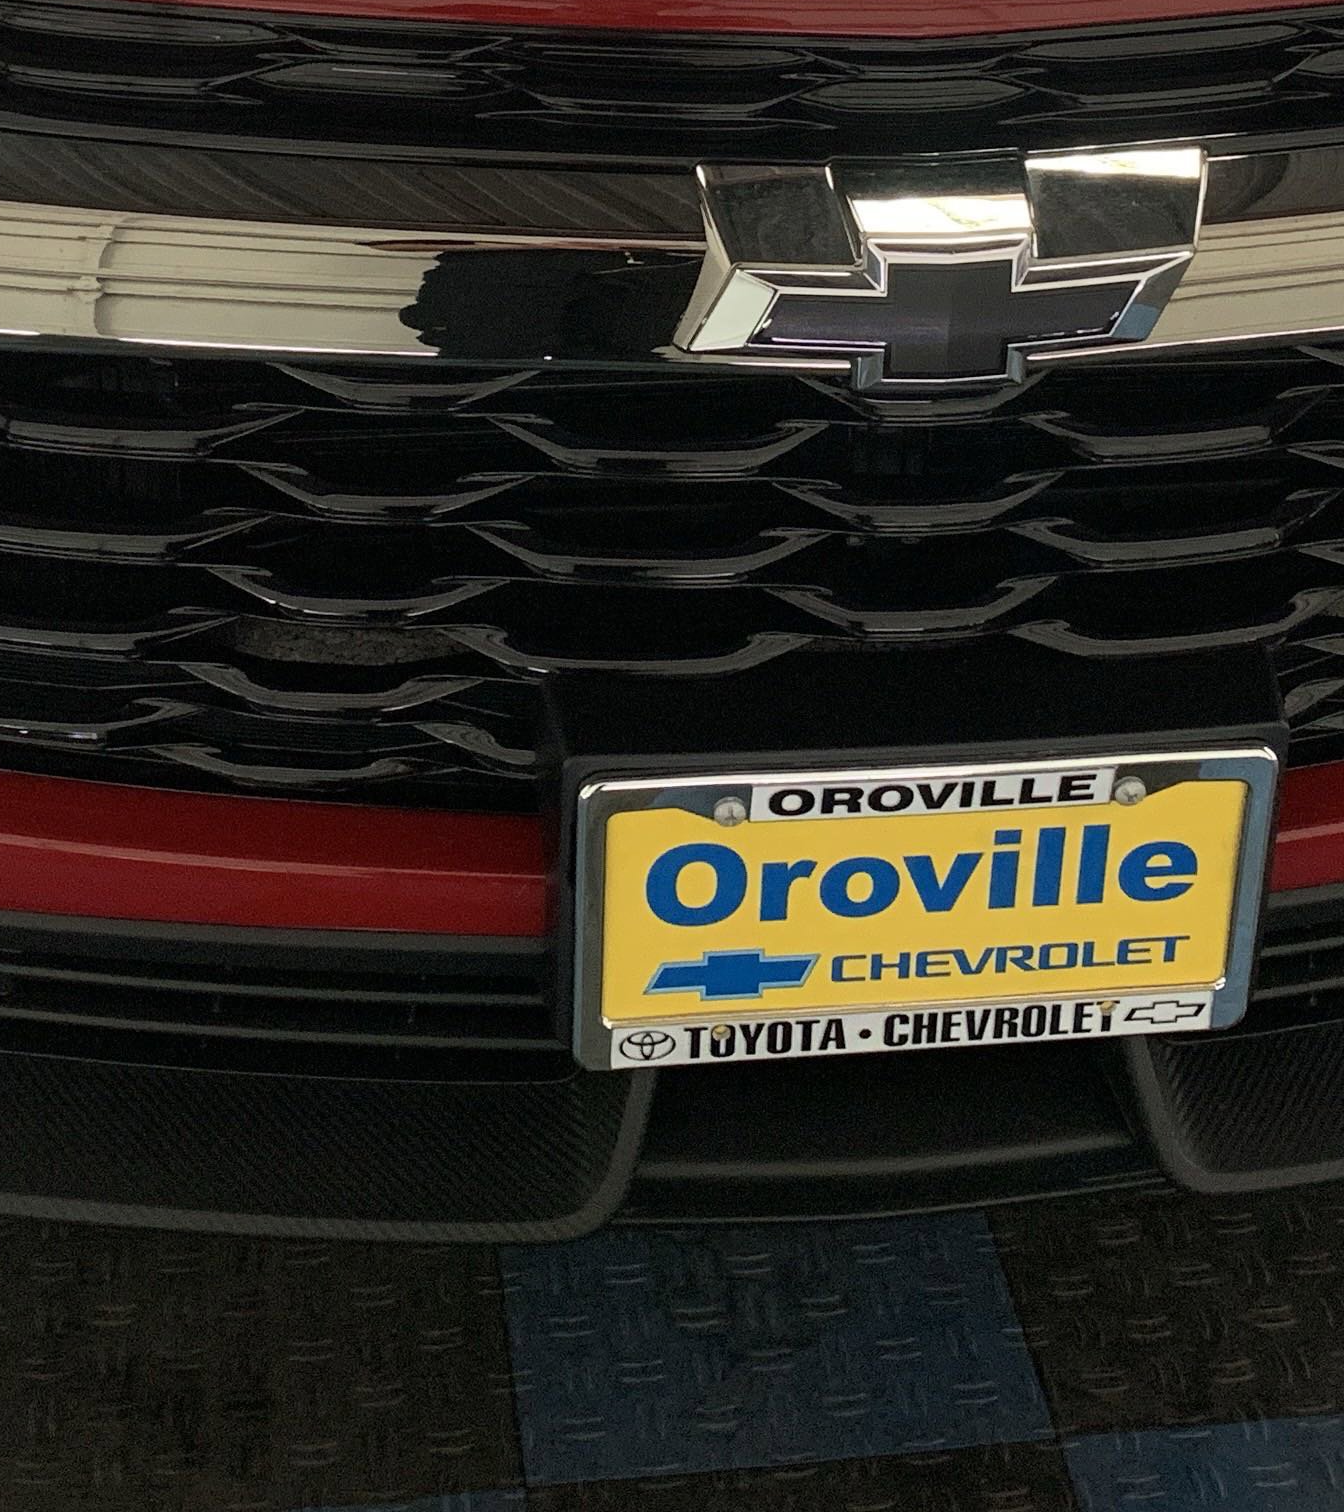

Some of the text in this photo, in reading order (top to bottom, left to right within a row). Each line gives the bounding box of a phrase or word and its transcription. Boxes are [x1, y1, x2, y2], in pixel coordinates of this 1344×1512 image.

[768, 775, 1098, 815] OROVILLE
[645, 824, 1199, 927] Oroville
[831, 935, 1191, 982] CHEVROLET
[685, 1000, 1121, 1060] TOYOTA CHEVROLET
